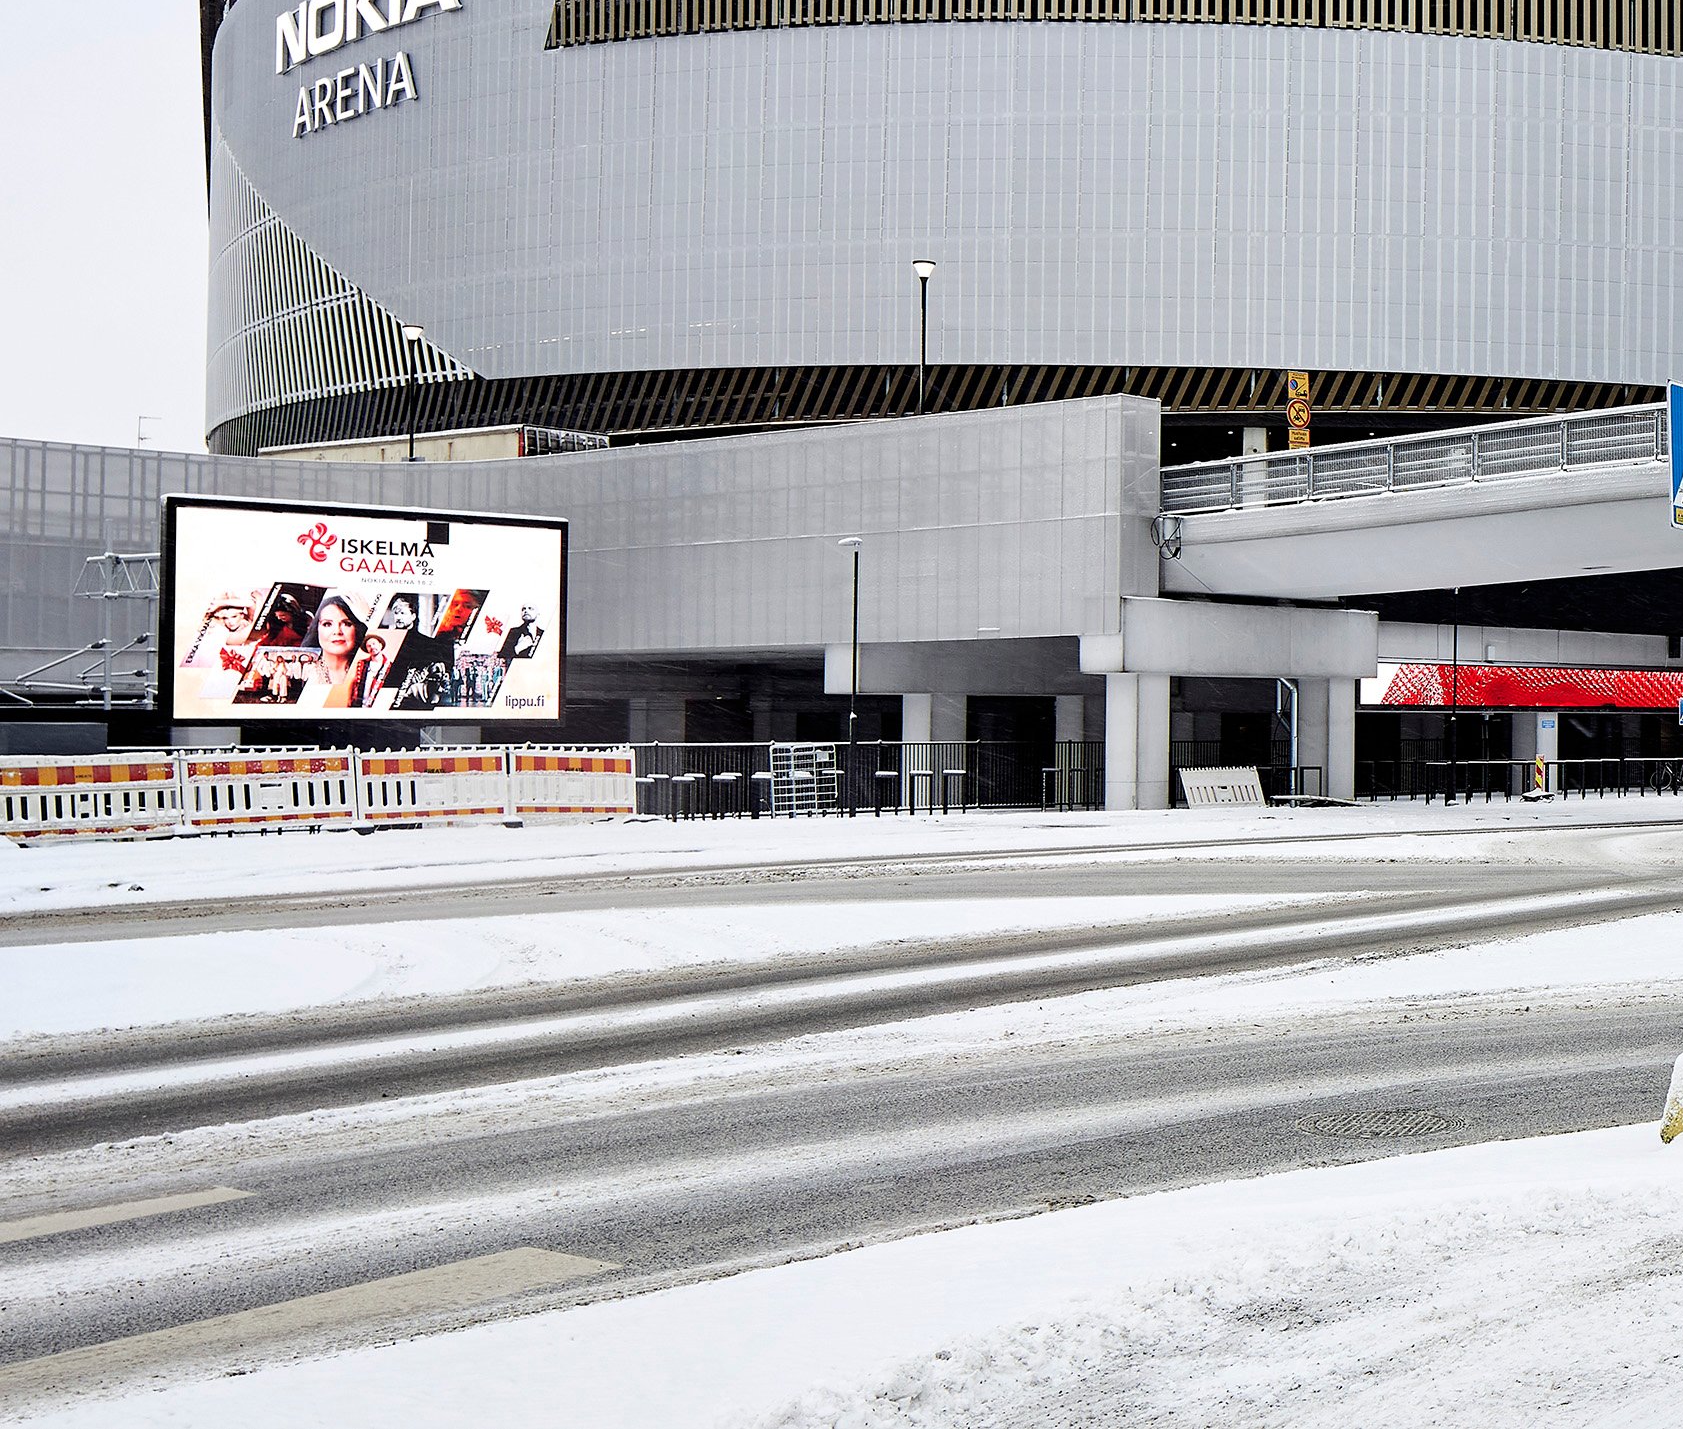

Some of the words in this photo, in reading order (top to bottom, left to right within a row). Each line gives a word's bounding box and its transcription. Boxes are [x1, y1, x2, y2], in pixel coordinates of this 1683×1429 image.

[292, 50, 419, 139] ARENA
[341, 538, 435, 558] ISKELMÄ
[339, 557, 416, 575] GAALA
[415, 560, 428, 568] 20
[421, 568, 434, 576] 22
[505, 695, 545, 710] lippu.fi
